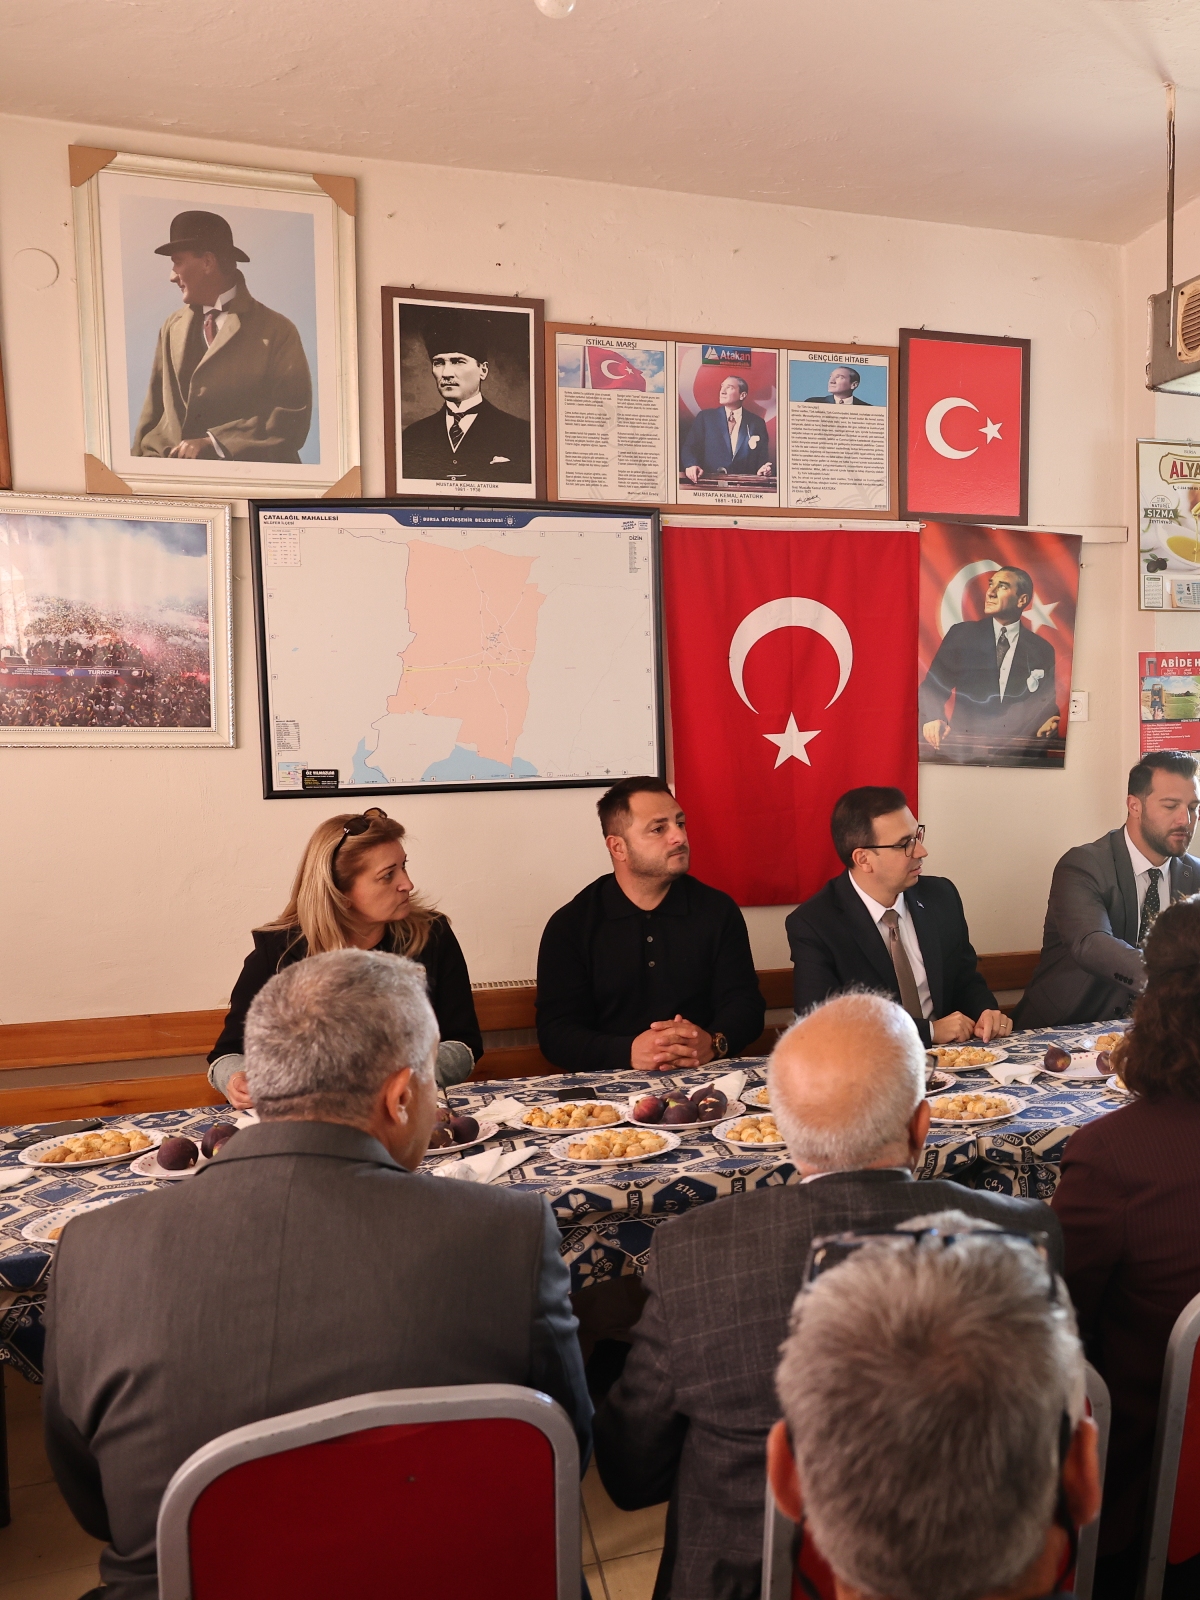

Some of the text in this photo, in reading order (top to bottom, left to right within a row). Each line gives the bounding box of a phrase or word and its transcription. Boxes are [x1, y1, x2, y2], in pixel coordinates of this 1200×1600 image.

[586, 337, 638, 350] İSTİKLAL MARŞI
[720, 350, 750, 360] Atakan
[808, 352, 869, 364] GENÇLİĞE HİTABE
[1161, 656, 1192, 668] ABİDE
